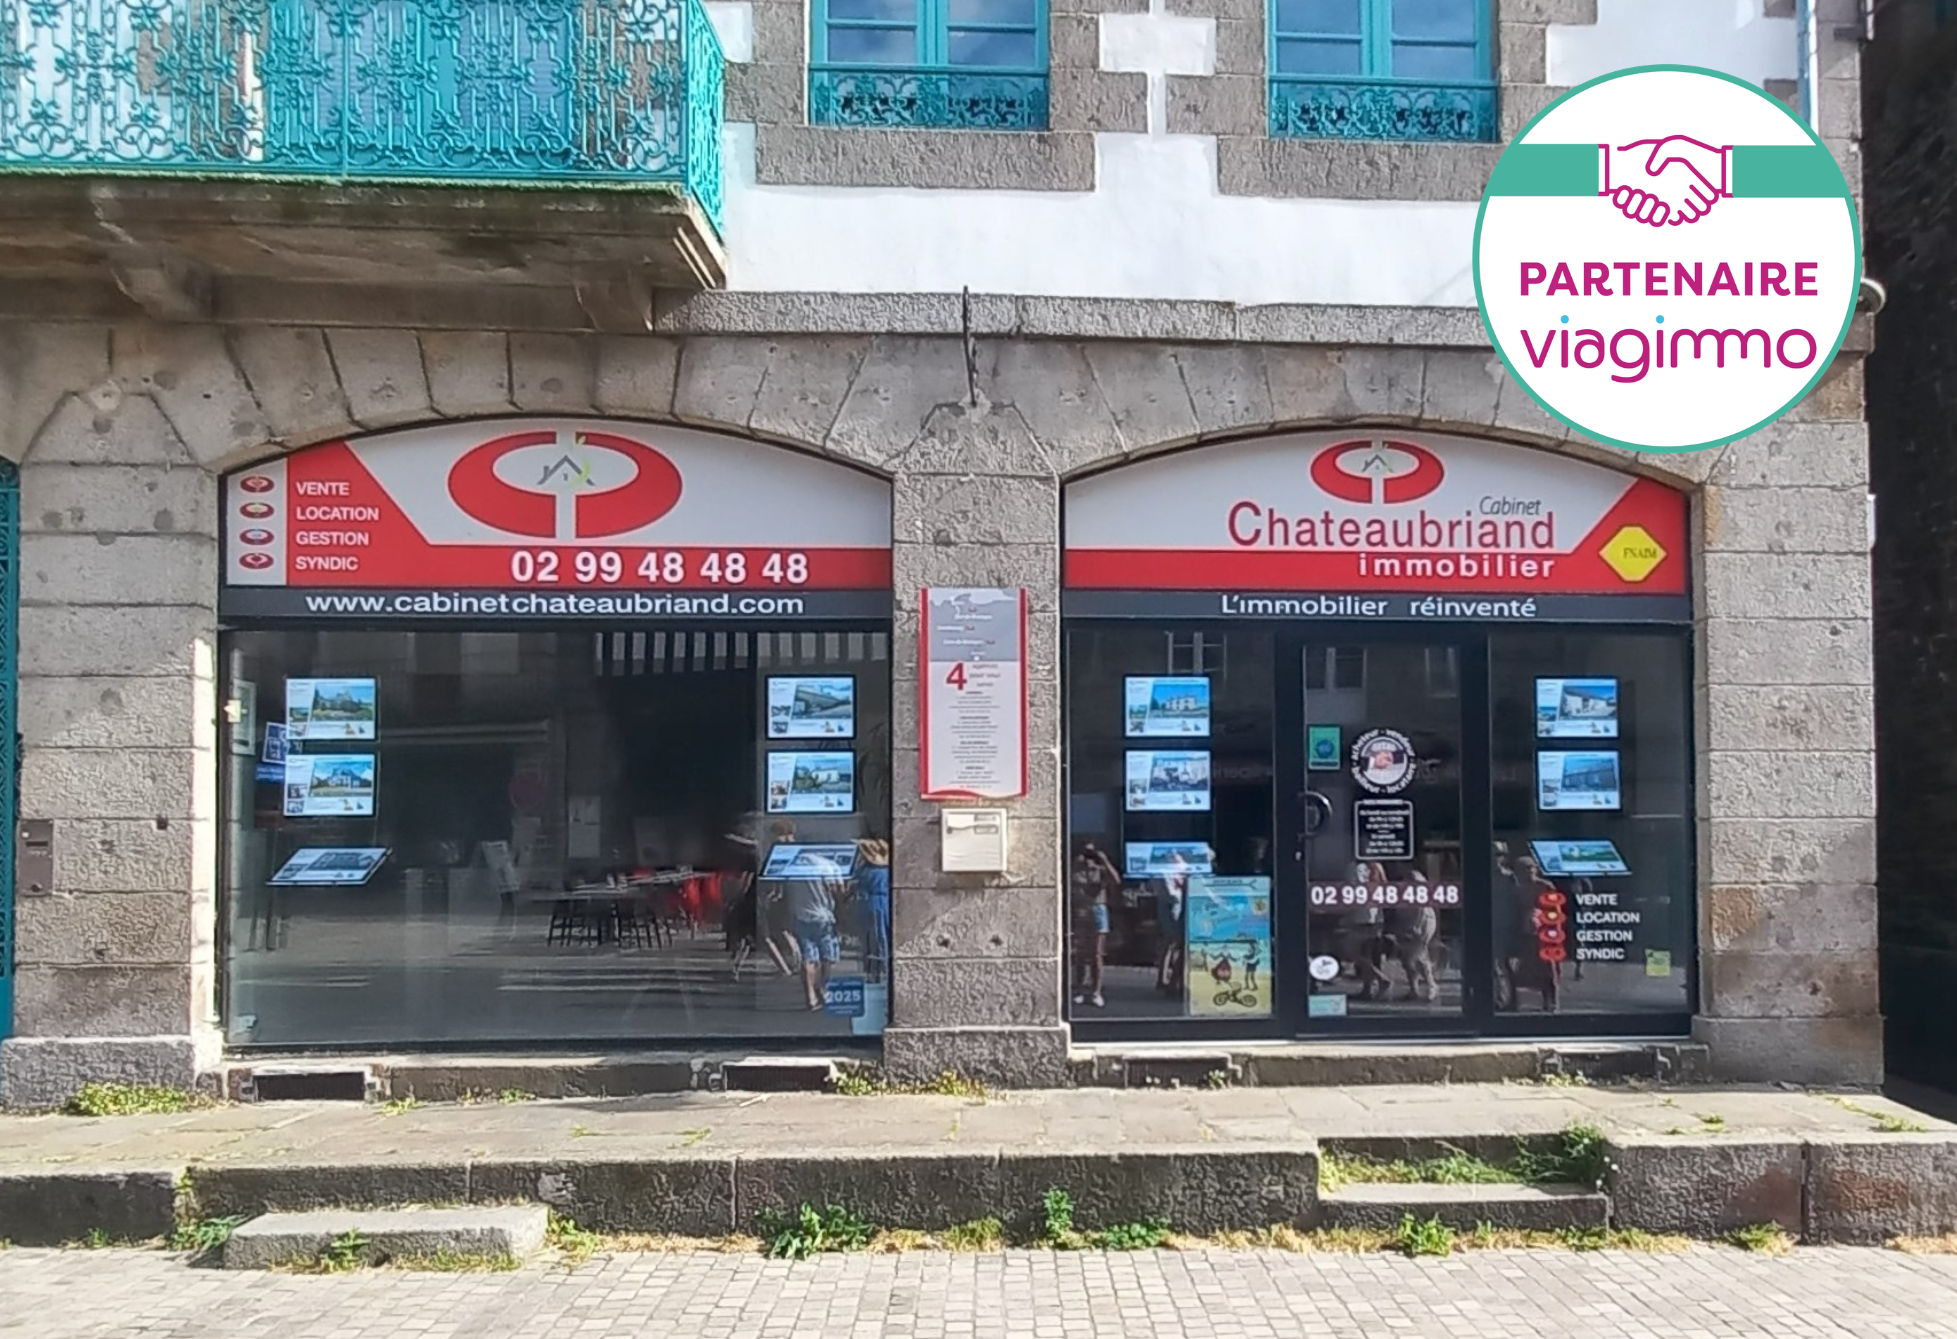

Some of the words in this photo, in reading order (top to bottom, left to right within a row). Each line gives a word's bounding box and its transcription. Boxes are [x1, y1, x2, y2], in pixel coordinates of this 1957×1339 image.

[295, 481, 350, 496] VENTE
[296, 506, 379, 521] LOCATION
[1479, 495, 1542, 516] Cabinet
[1228, 500, 1555, 549] Chateaubriand
[295, 531, 369, 546] GESTION
[295, 555, 359, 571] SYNDIC
[511, 550, 559, 582] 02
[574, 550, 622, 583] 99
[637, 551, 685, 583] 48
[699, 552, 747, 583] 48
[761, 552, 808, 584] 48
[1359, 552, 1555, 578] immobilier
[305, 592, 804, 615] www.cabinetchateaubriand.com
[1409, 597, 1537, 618] réinventé
[945, 661, 968, 691] 4
[1311, 885, 1338, 904] 02
[1342, 885, 1368, 904] 99
[1372, 885, 1398, 904] 48
[1402, 885, 1429, 904] 48
[1433, 885, 1459, 903] 48
[1575, 893, 1618, 906] VENTE
[1575, 911, 1640, 924] LOCATION
[1575, 929, 1633, 942] GESTION
[1575, 947, 1625, 960] SYNDIC
[824, 989, 861, 1003] 2025
